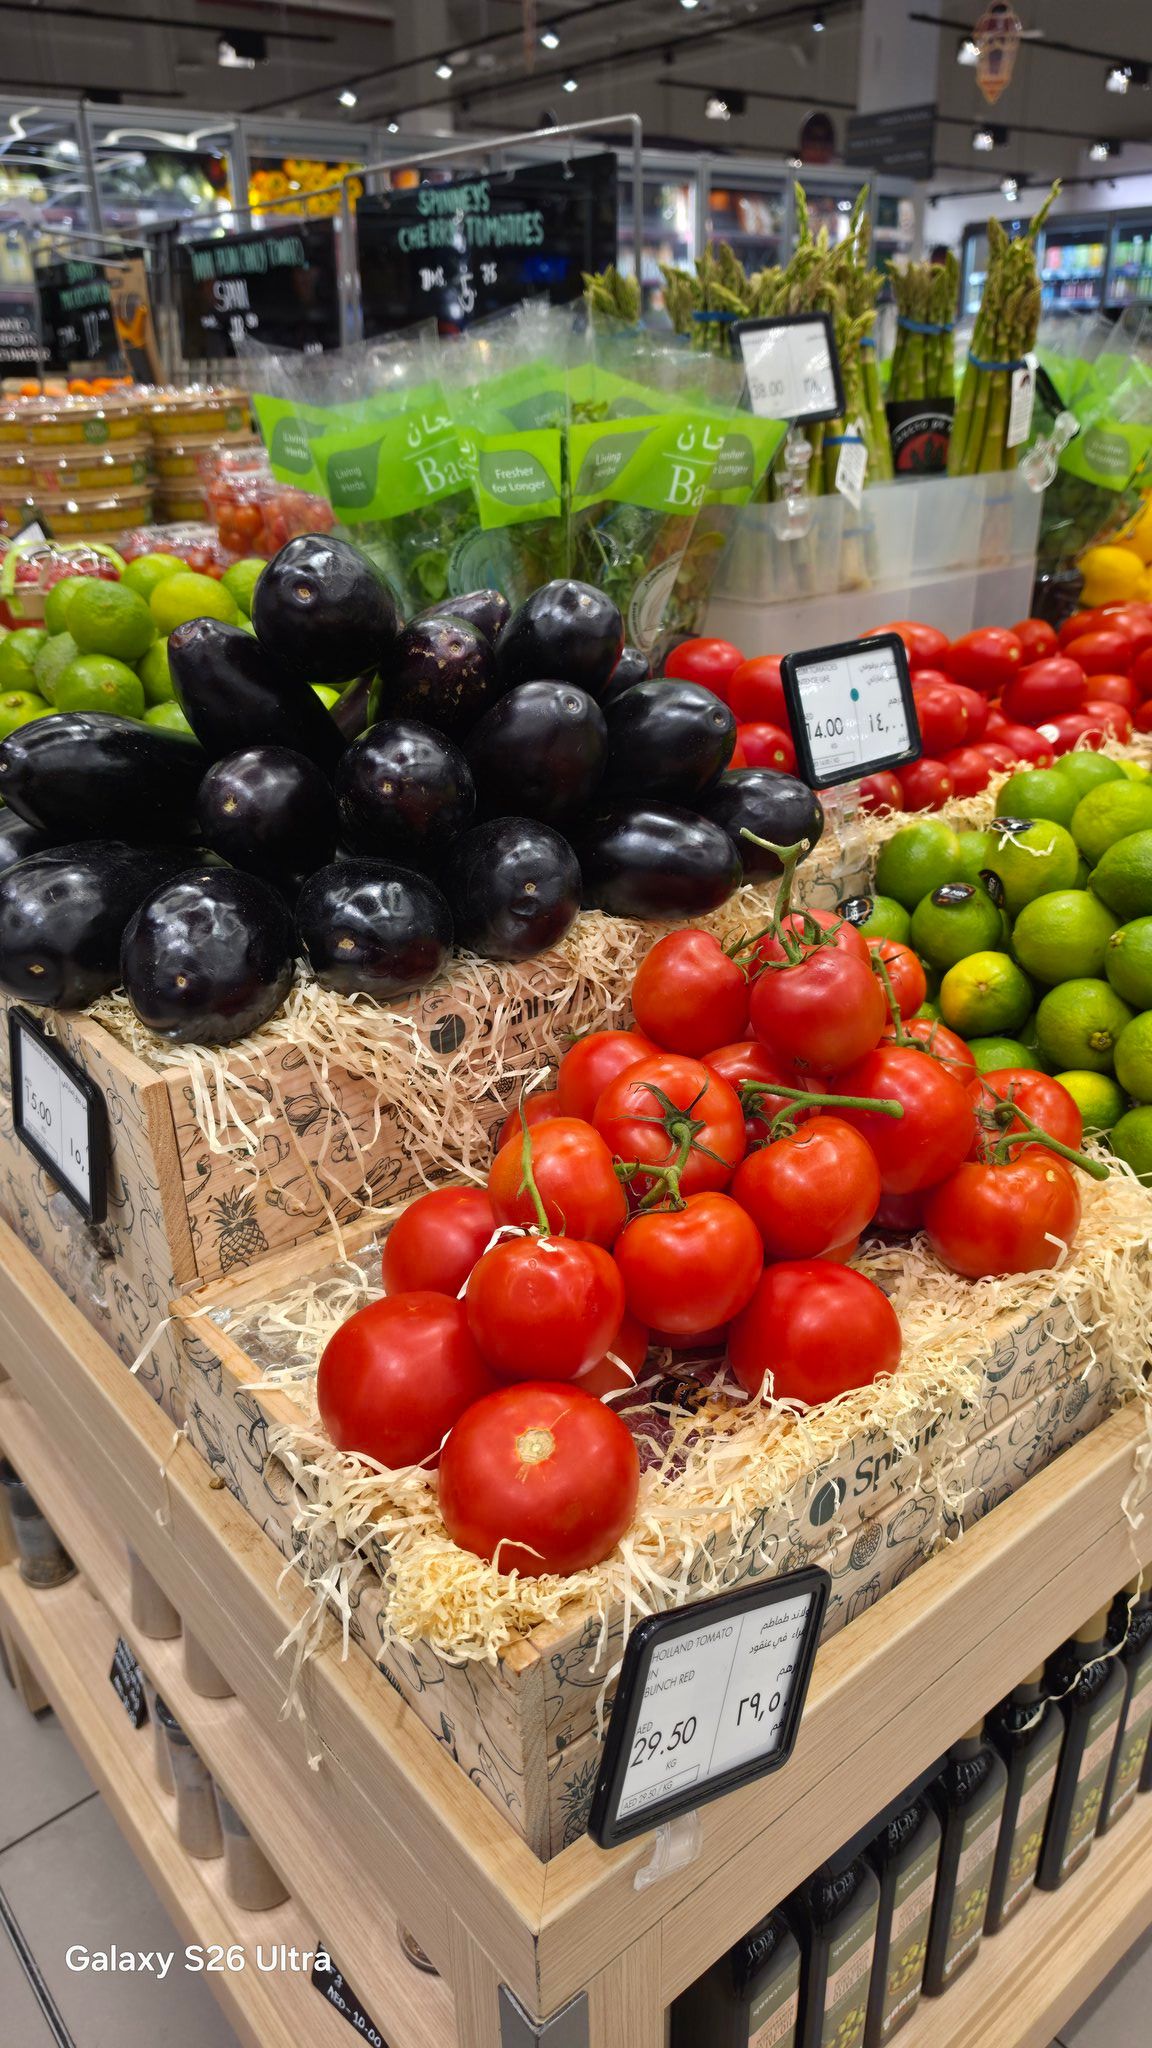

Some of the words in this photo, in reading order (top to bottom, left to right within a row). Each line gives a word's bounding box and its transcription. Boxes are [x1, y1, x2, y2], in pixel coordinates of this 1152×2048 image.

[494, 466, 534, 479] Fresher
[491, 482, 507, 493] for
[508, 480, 546, 493] Longer
[805, 717, 845, 741] 14.00
[25, 1084, 52, 1127] 15.00
[651, 1639, 693, 1664] HOLLAND
[695, 1626, 734, 1648] TOMATO
[643, 1676, 678, 1698] BUNCH
[678, 1669, 696, 1685] RED
[647, 1668, 660, 1681] IN
[635, 1720, 654, 1736] AED
[630, 1715, 697, 1769] 29.50
[665, 1757, 678, 1770] KG
